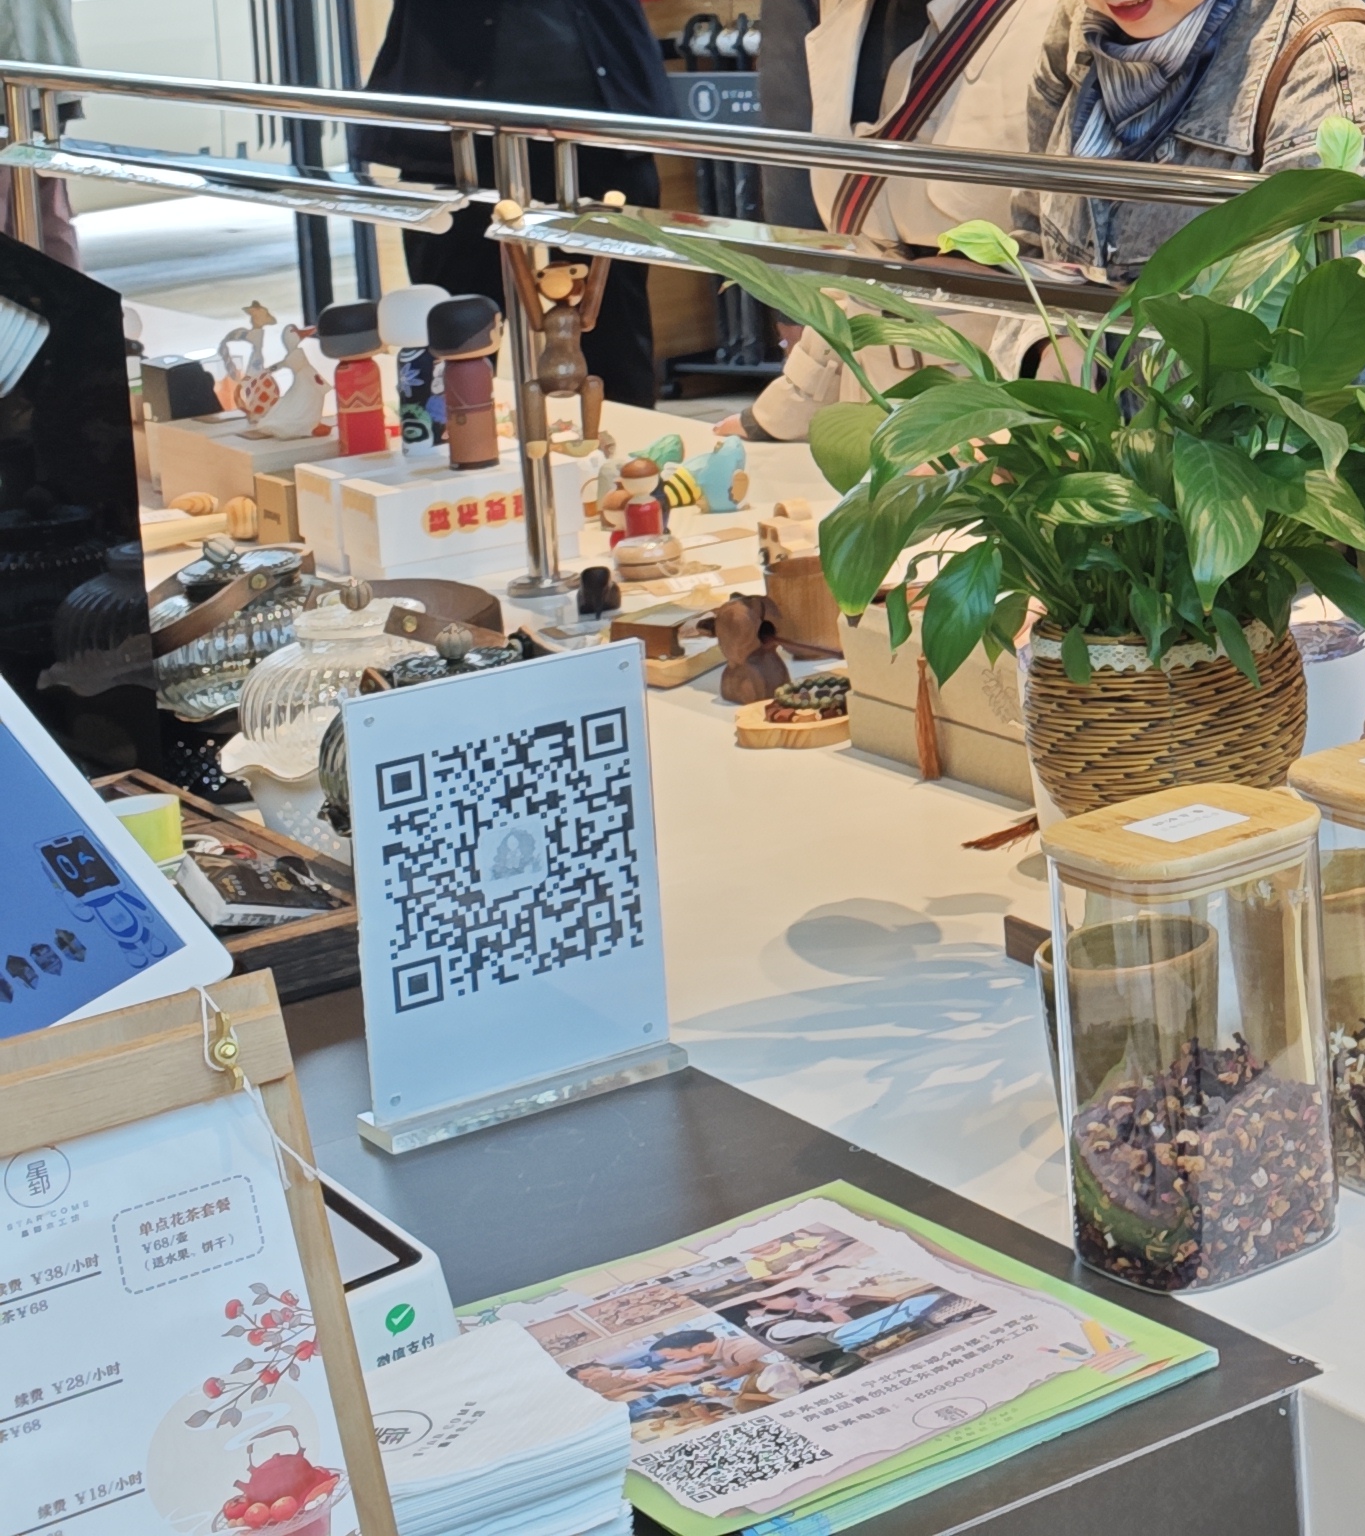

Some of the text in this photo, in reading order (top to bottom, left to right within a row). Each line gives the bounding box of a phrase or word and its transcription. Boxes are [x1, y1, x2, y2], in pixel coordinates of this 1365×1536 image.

[138, 1196, 232, 1238] 单点花茶套餐
